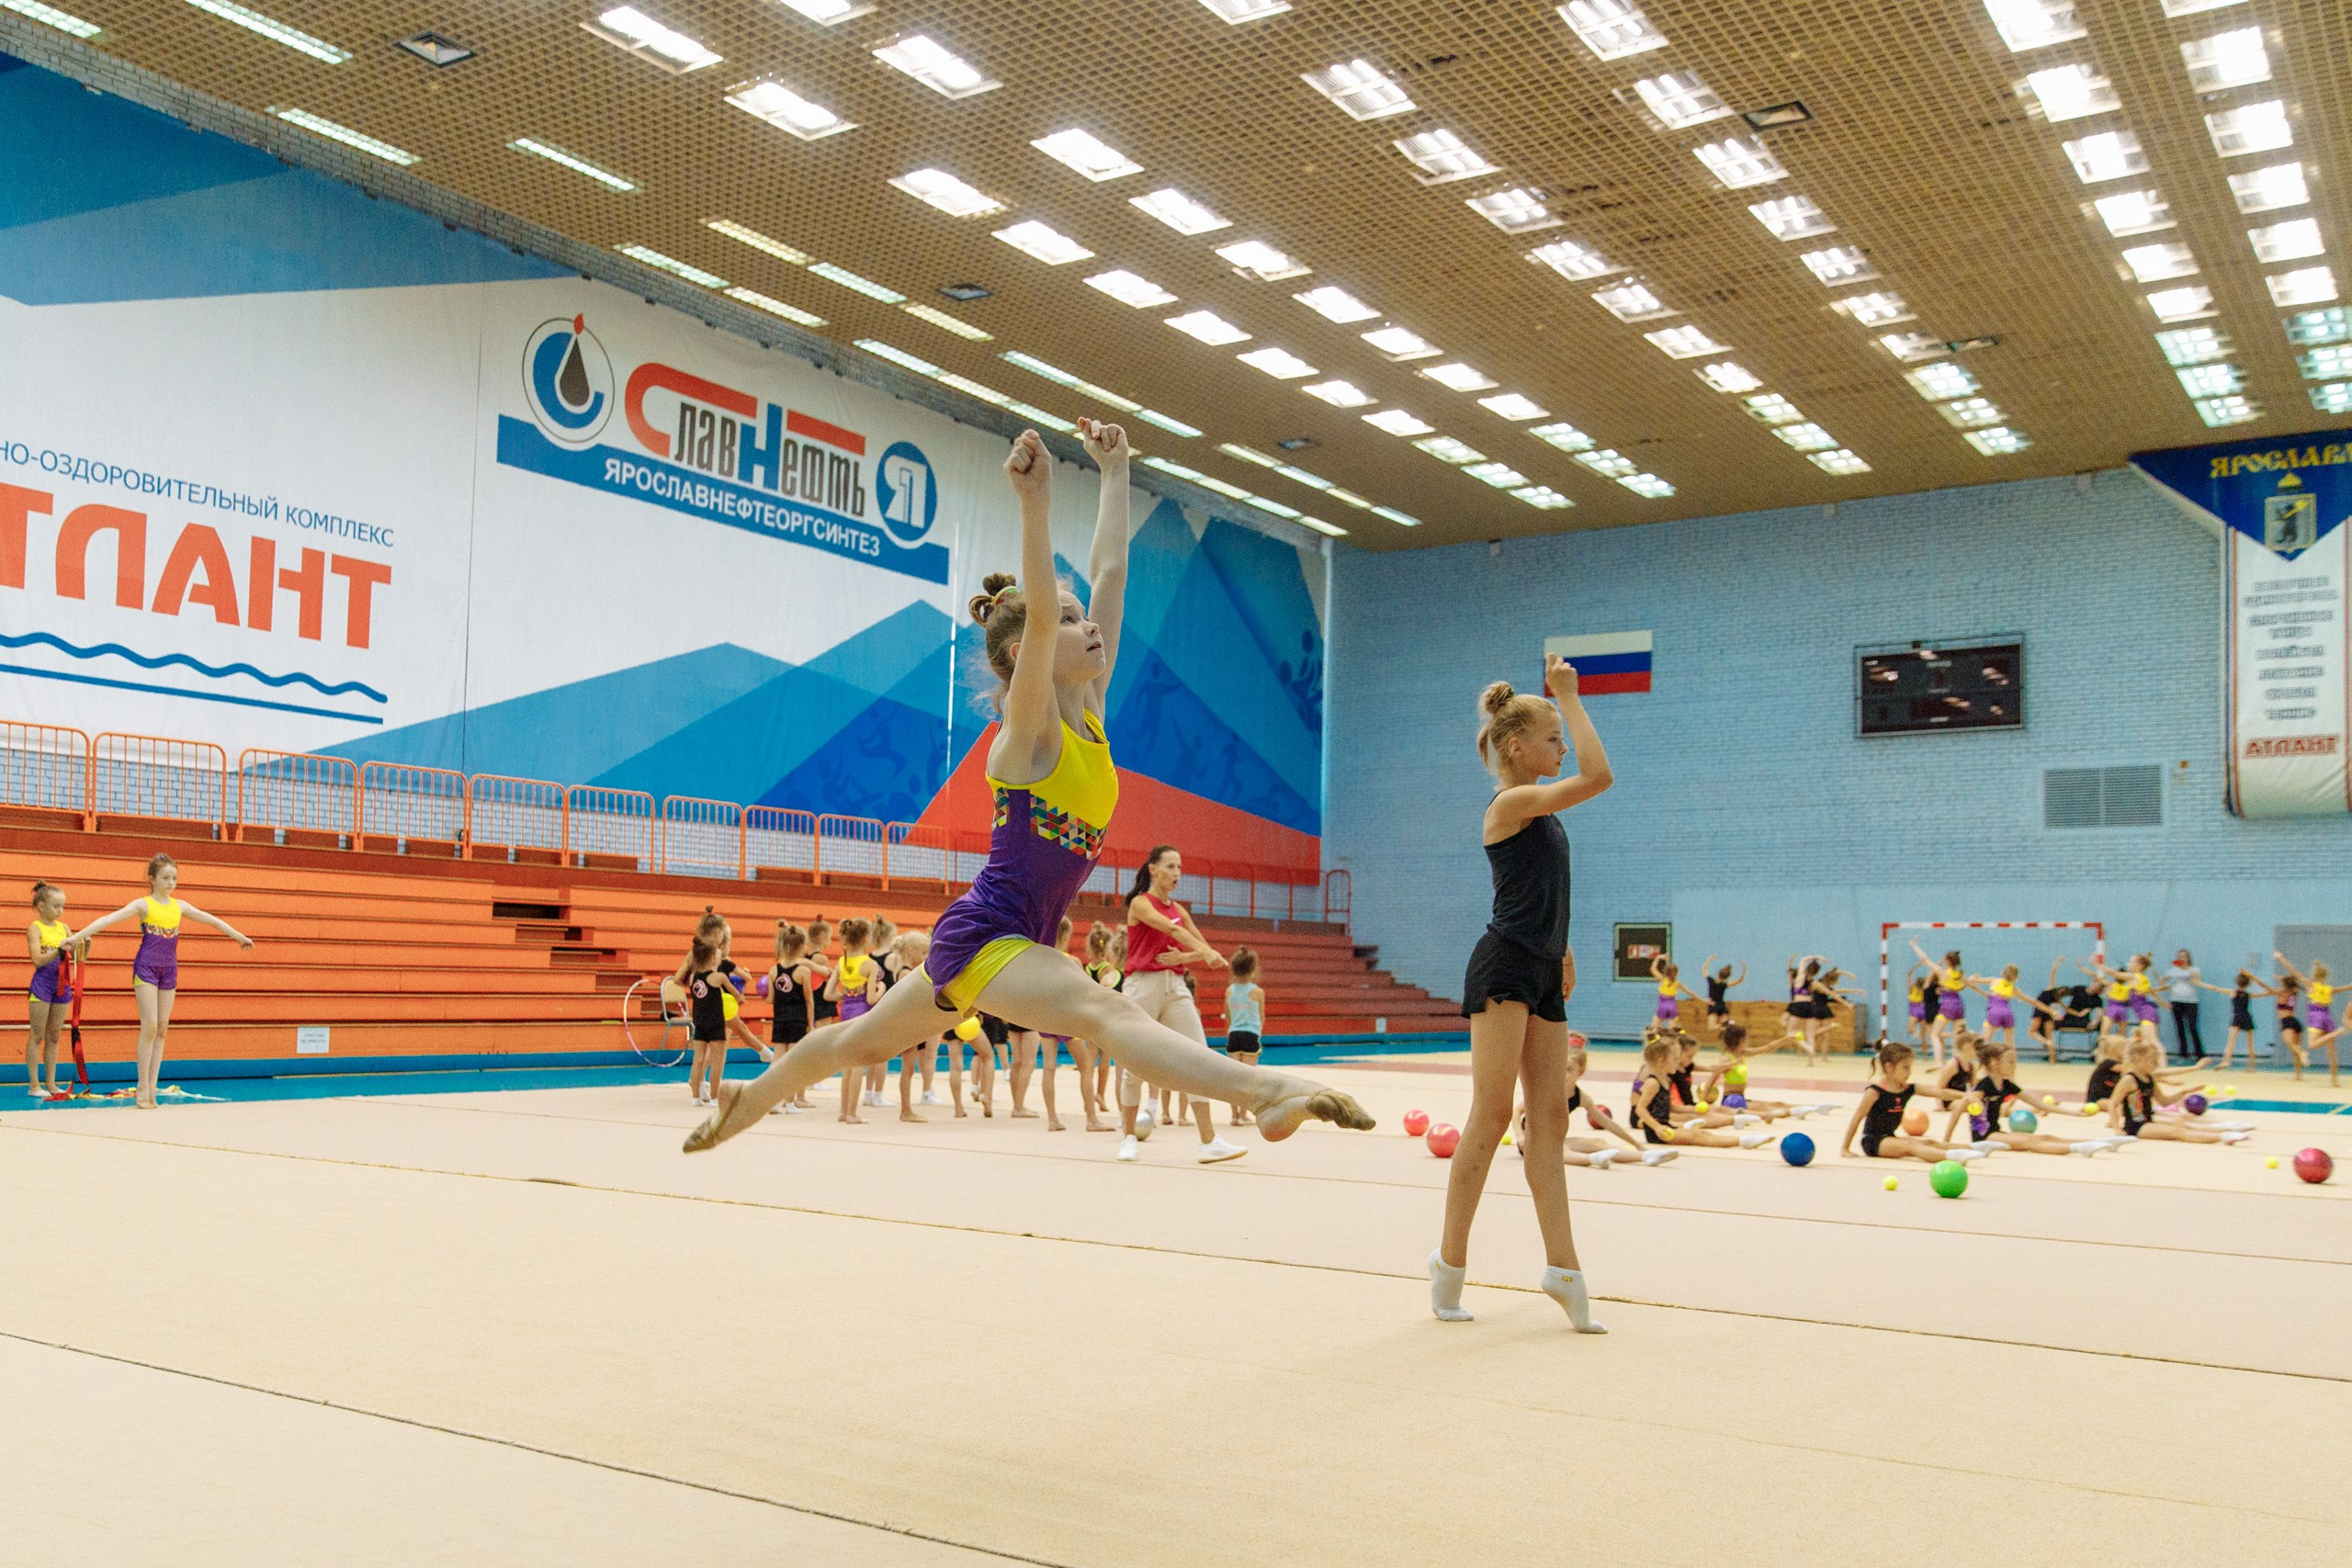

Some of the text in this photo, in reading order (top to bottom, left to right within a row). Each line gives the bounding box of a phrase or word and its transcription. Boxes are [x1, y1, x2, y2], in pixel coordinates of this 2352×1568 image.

[625, 362, 865, 518] СлавНефть
[287, 506, 394, 547] КОМПЛЕКС
[605, 457, 880, 557] ЯРОСЛАВНЕФТЕОРГСИНТЕЗ
[2245, 734, 2337, 758] АТЛАНТ
